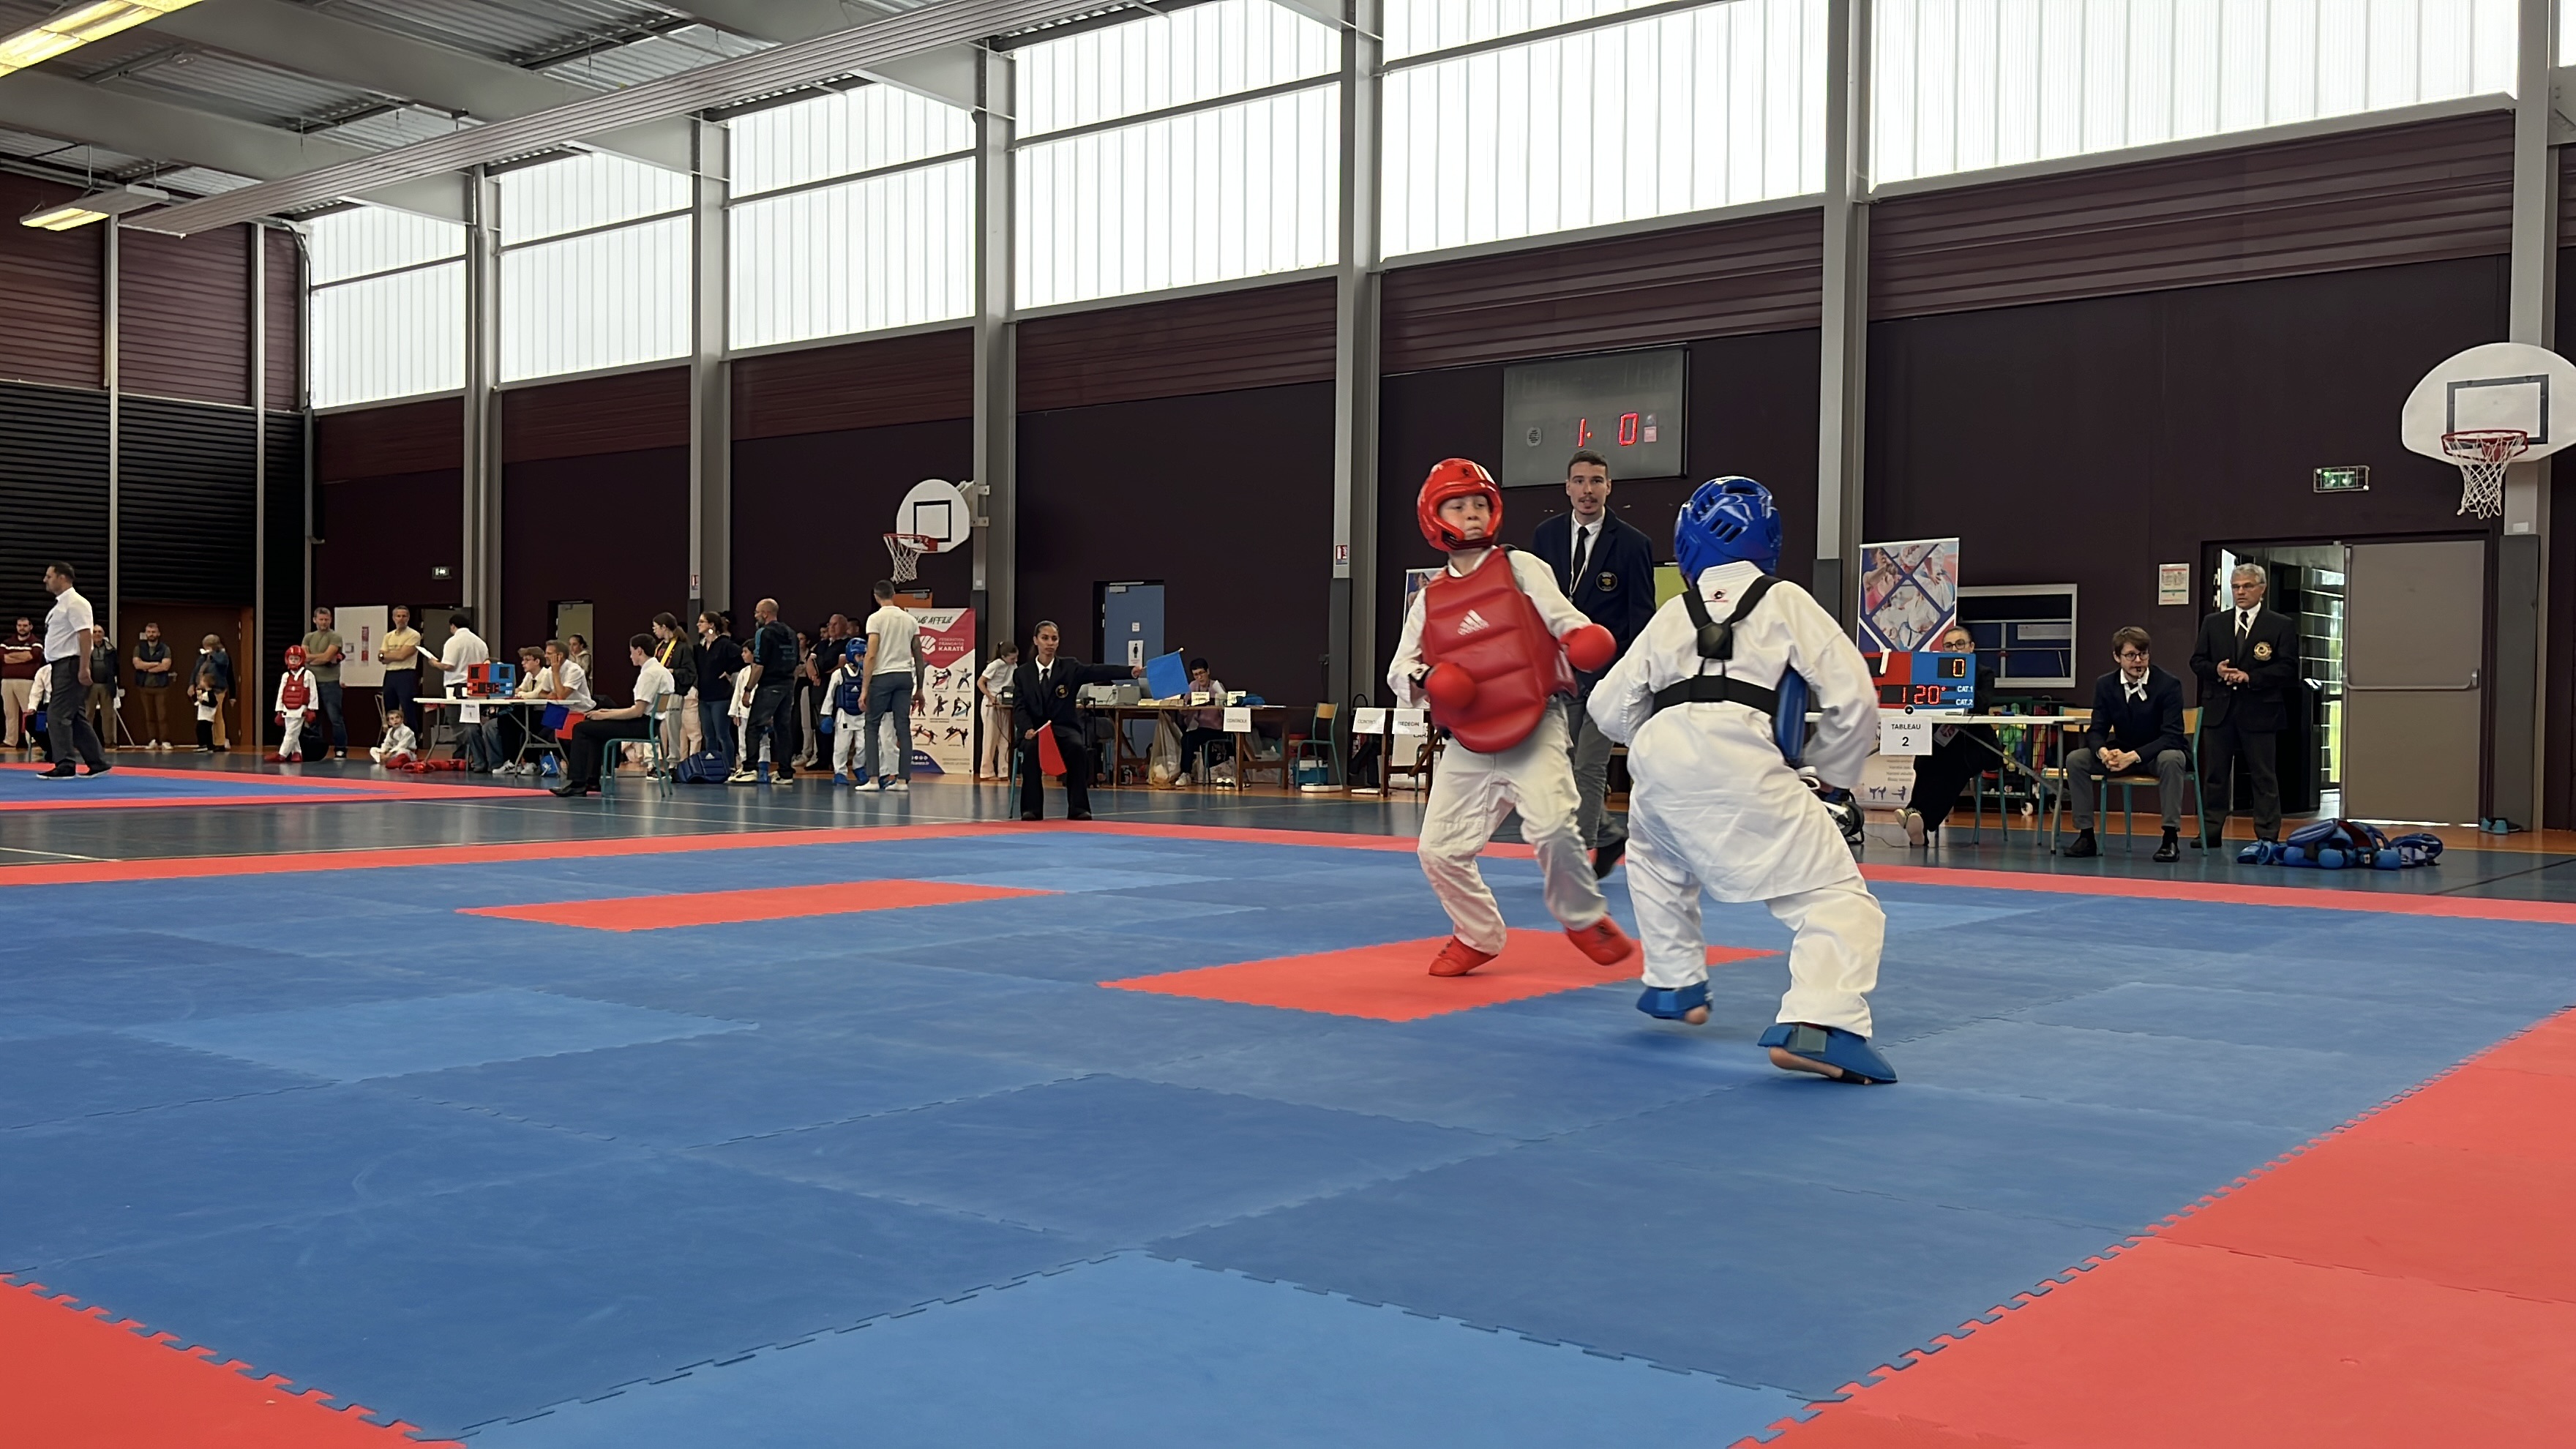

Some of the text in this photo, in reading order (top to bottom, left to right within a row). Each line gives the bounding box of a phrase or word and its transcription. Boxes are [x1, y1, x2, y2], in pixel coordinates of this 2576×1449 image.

[1953, 659, 1965, 677] 0
[1957, 685, 1974, 693] CAT.1
[1955, 698, 1974, 706] CAT.2
[1901, 736, 1909, 747] 2
